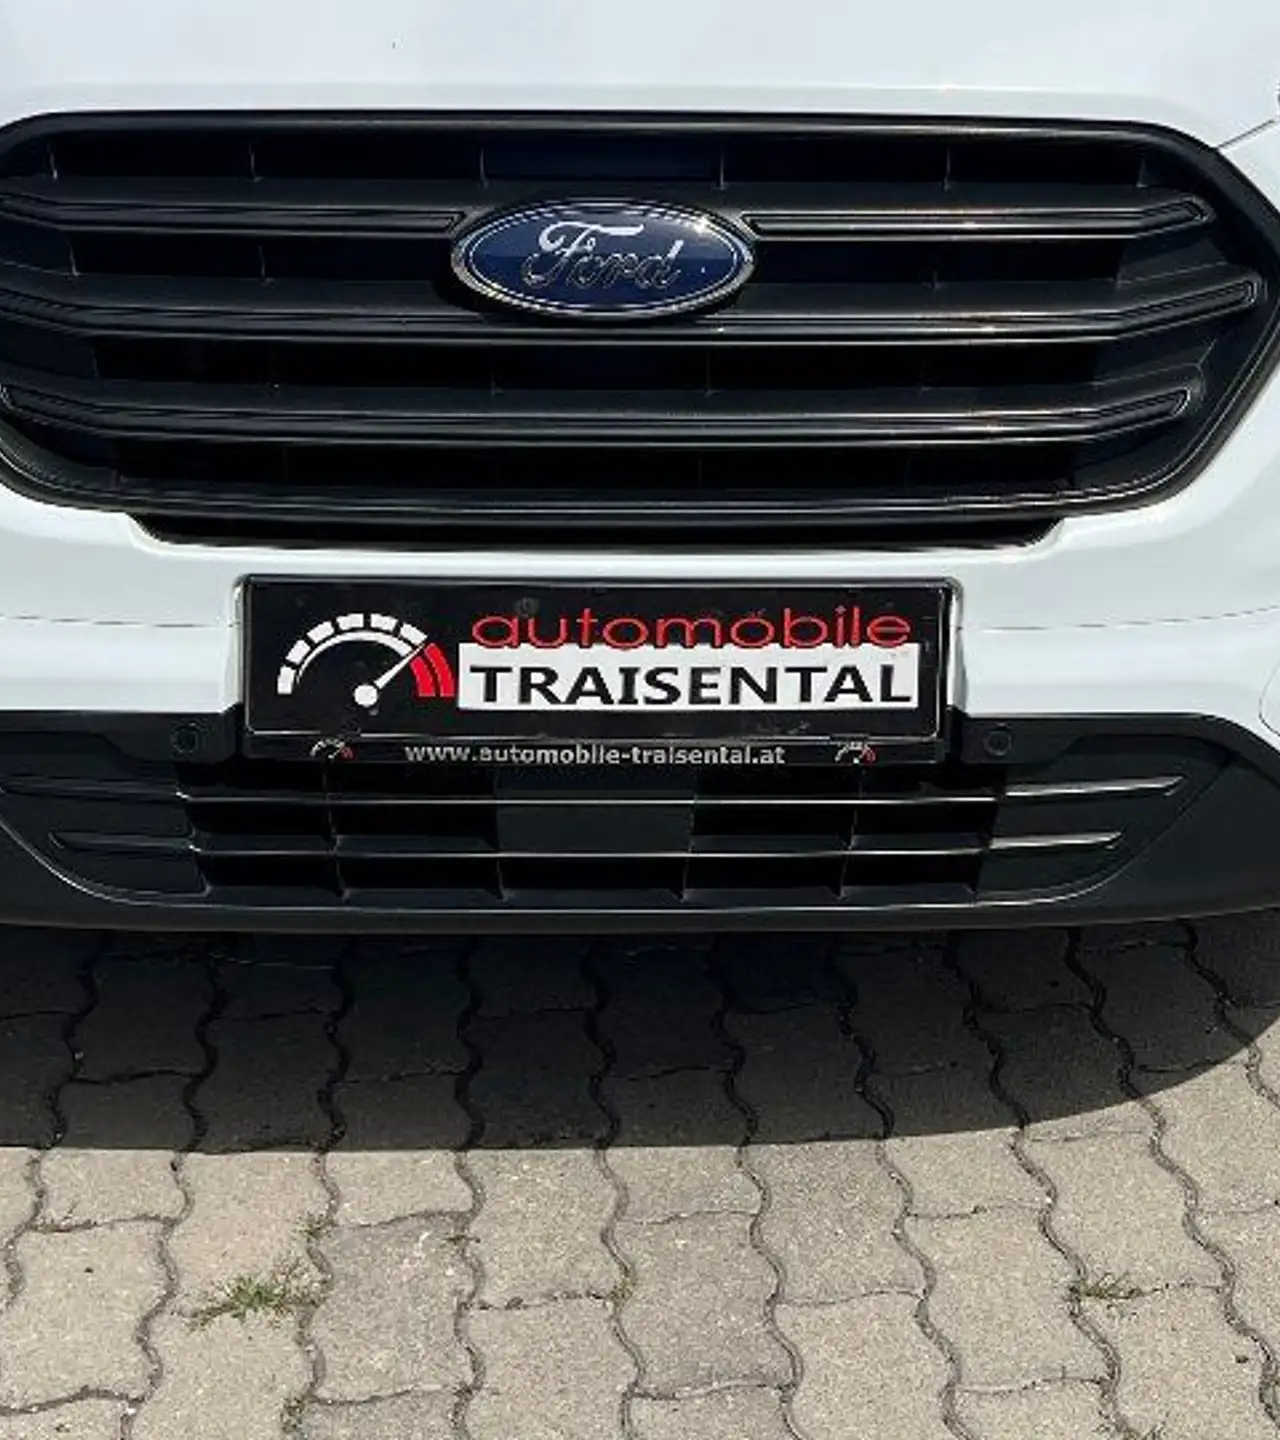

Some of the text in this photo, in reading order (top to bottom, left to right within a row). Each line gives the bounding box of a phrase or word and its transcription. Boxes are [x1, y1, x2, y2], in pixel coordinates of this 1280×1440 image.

[523, 220, 684, 290] Ford
[471, 606, 911, 649] automobile
[470, 664, 912, 706] TRAISENTAL
[404, 744, 786, 765] www.automobile-traisental.at
